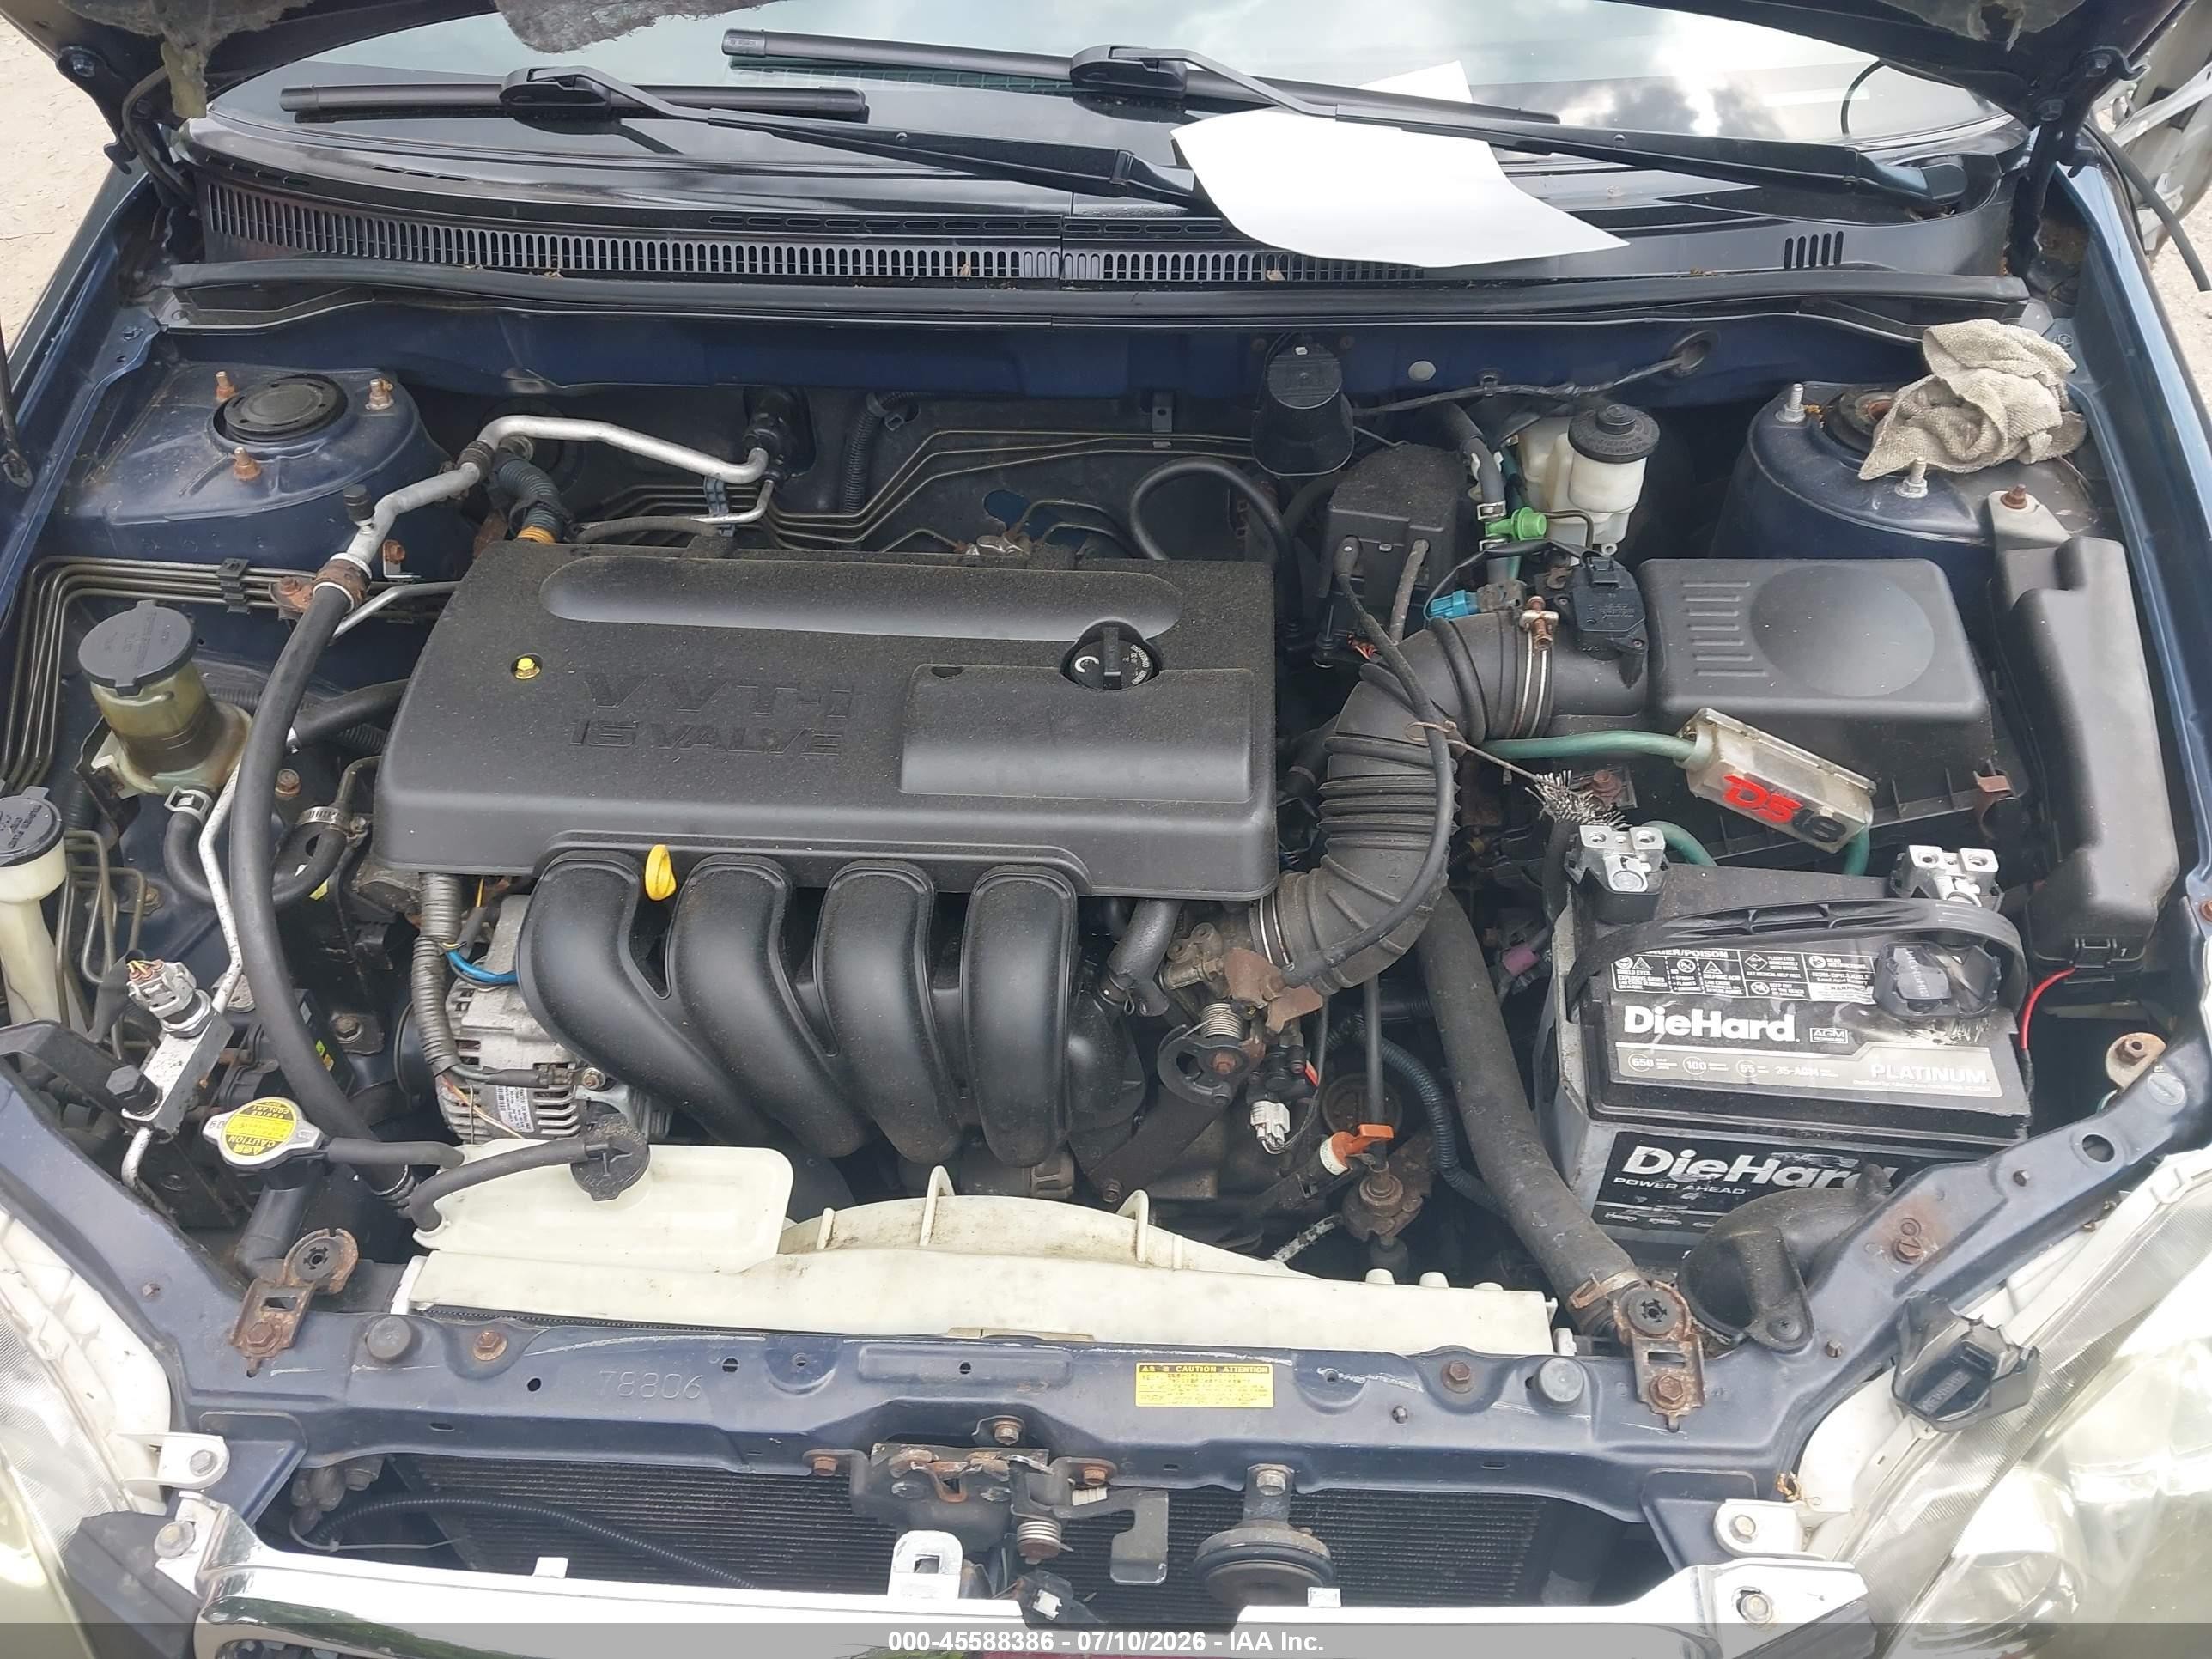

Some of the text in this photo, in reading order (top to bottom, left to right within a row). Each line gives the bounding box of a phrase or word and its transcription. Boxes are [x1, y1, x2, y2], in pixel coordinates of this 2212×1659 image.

[570, 720, 842, 756] 16 VALVE
[1723, 773, 1847, 843] DS18
[1814, 1030, 1845, 1038] AGM
[1632, 1057, 1654, 1067] 650
[1686, 1060, 1707, 1071] 100
[1870, 1064, 1989, 1084] PLATINUM
[228, 1134, 276, 1149] CAUTION
[1613, 1176, 1747, 1195] POWER AHEAD
